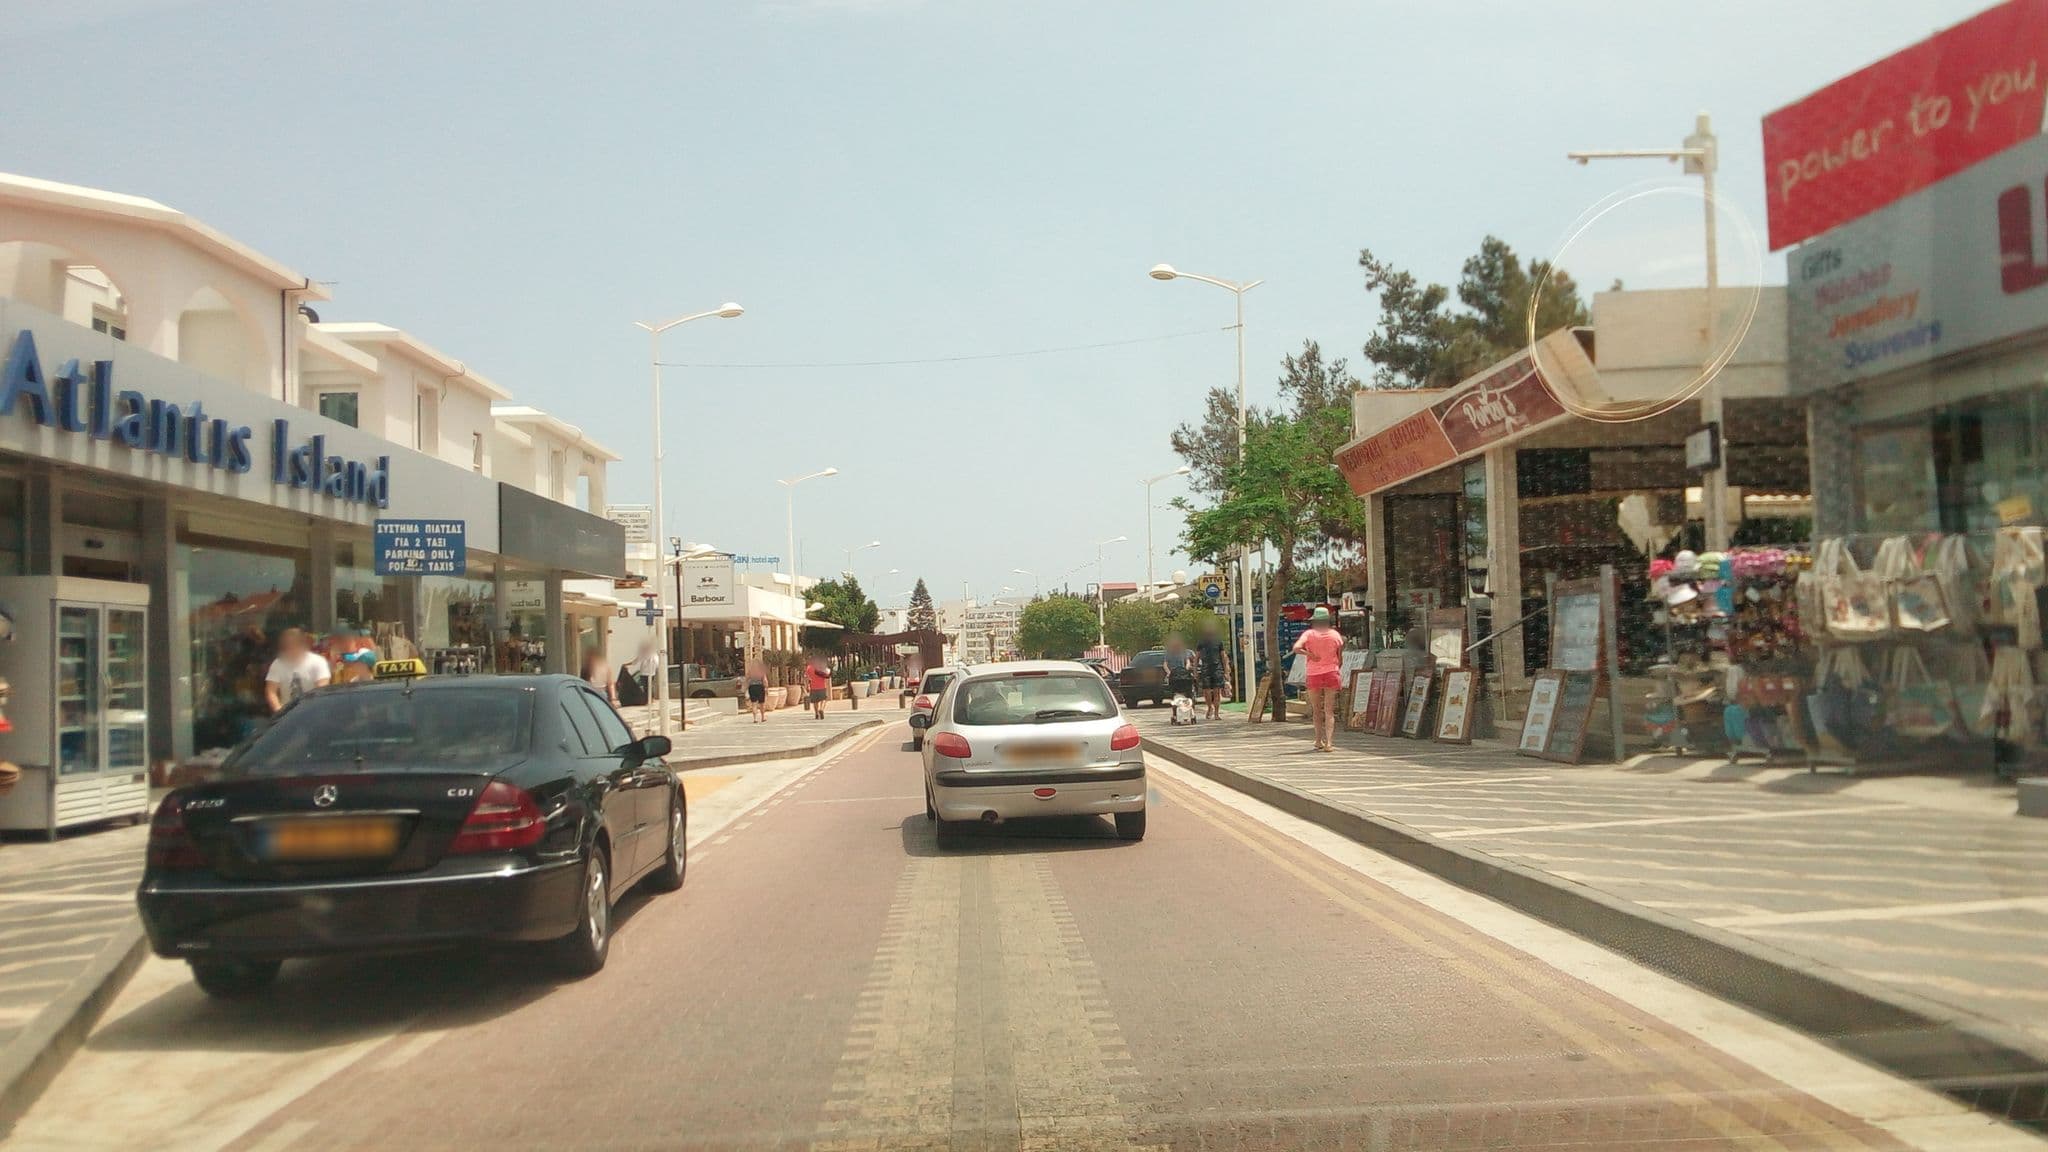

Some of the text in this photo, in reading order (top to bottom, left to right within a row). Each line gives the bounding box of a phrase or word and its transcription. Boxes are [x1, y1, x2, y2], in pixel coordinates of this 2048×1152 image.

[1779, 57, 2037, 204] power to you
[0, 329, 391, 510] Atlantis Island
[377, 523, 463, 534] ΣΥΣΤΗΜΑ ΠΙΑΤΣΑΣ
[394, 537, 447, 547] ΓΙΑ 2 ΤΑΞΙ
[384, 549, 455, 560] PARKING ONLY
[427, 561, 455, 572] TAXIS
[1202, 575, 1223, 583] ATM
[690, 594, 725, 603] Barbour
[380, 662, 414, 673] TAXI
[447, 788, 474, 797] CDI
